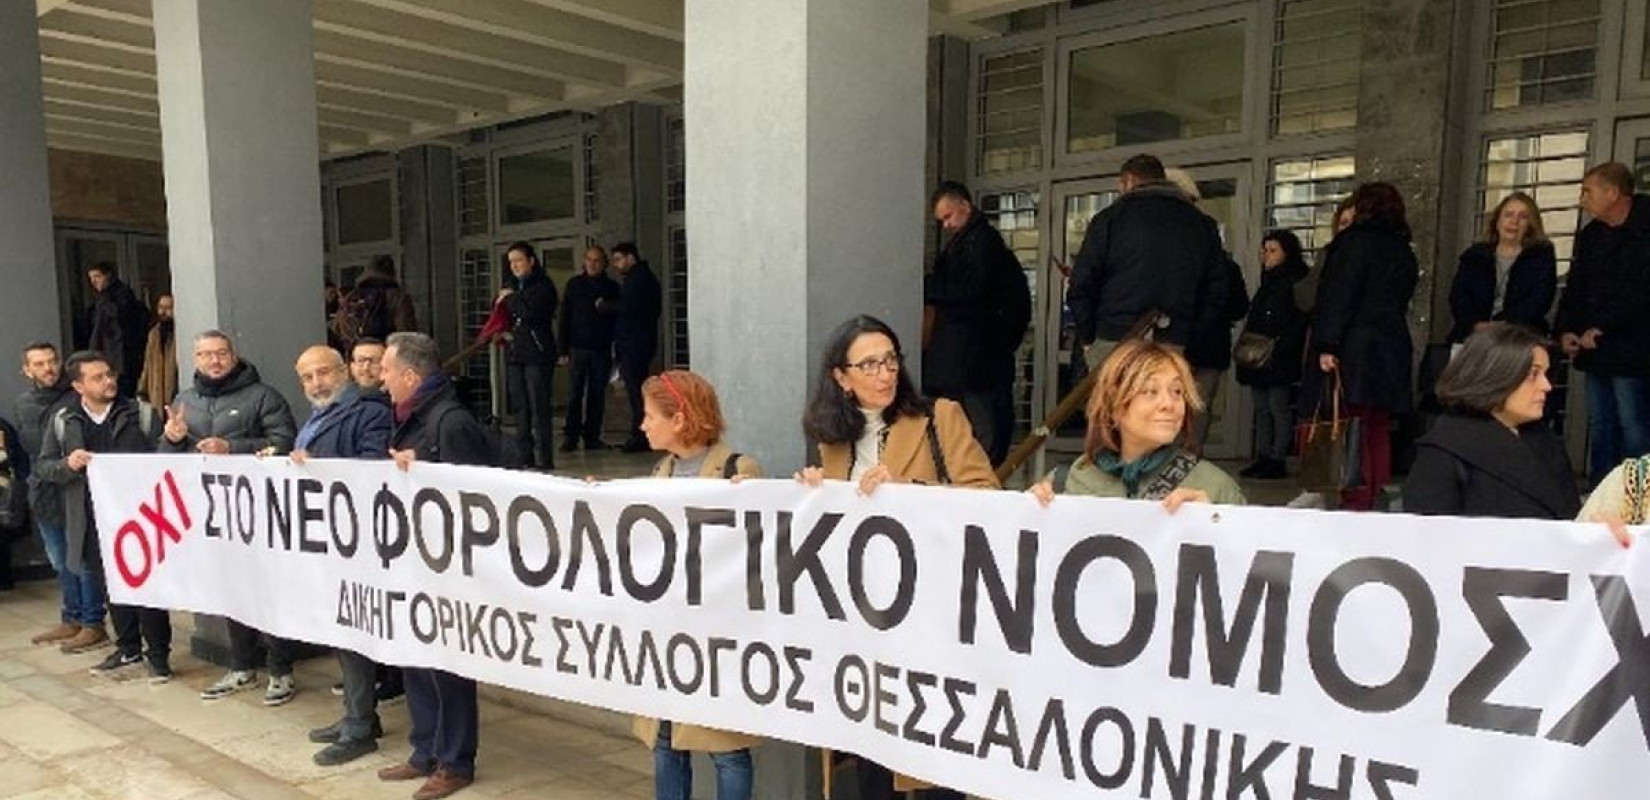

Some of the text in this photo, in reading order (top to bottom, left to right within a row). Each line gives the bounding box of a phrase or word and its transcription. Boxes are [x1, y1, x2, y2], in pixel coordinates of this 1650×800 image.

[113, 469, 192, 589] ΟΧΙ
[201, 473, 255, 545] ΣΤΟ
[266, 477, 359, 558] ΝΕΟ
[373, 482, 918, 631] ΦΟΡΟΛΟΓΙΚΟ
[336, 578, 542, 667] ΔΙΚΗΓΟΡΙΚΟΣ
[552, 616, 814, 713] ΣΥΛΛΟΓΟΣ
